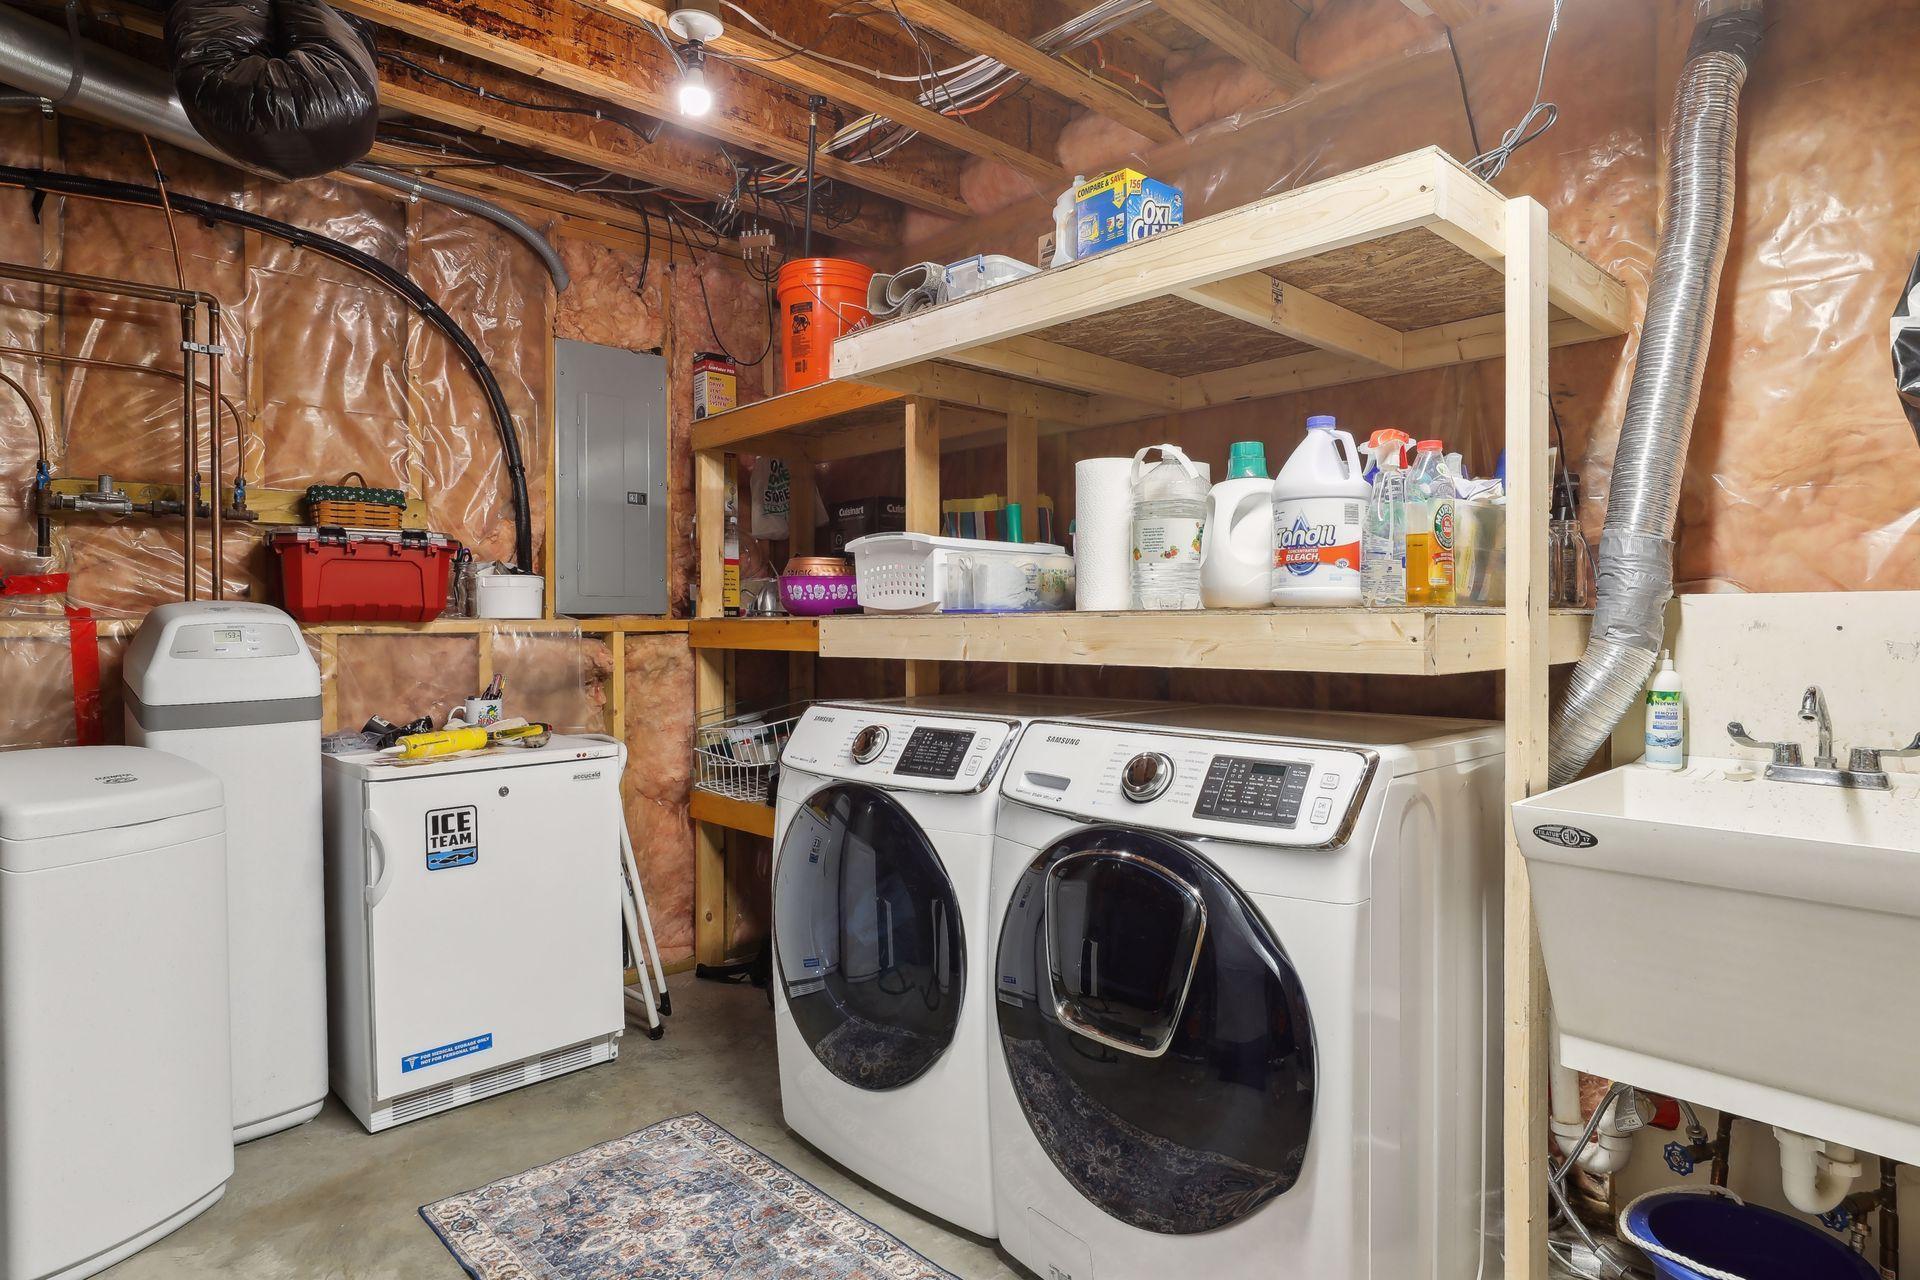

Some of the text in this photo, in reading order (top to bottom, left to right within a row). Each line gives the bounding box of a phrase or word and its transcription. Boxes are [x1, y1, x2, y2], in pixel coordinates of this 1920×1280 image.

[1077, 172, 1125, 198] COMPARE & SAVE
[1130, 179, 1141, 189] 156
[1143, 200, 1170, 225] OXI
[839, 505, 864, 517] Cuisinart
[1277, 525, 1336, 548] Tandil
[1285, 552, 1318, 562] BLEACH
[1046, 735, 1081, 746] SAMSUNG
[431, 811, 471, 835] ICE
[430, 832, 471, 848] TEAM
[431, 1047, 454, 1056] MEDICAL
[454, 1041, 477, 1050] STORAGE
[476, 1036, 490, 1044] ONLY
[442, 1048, 468, 1059] PERSONAL
